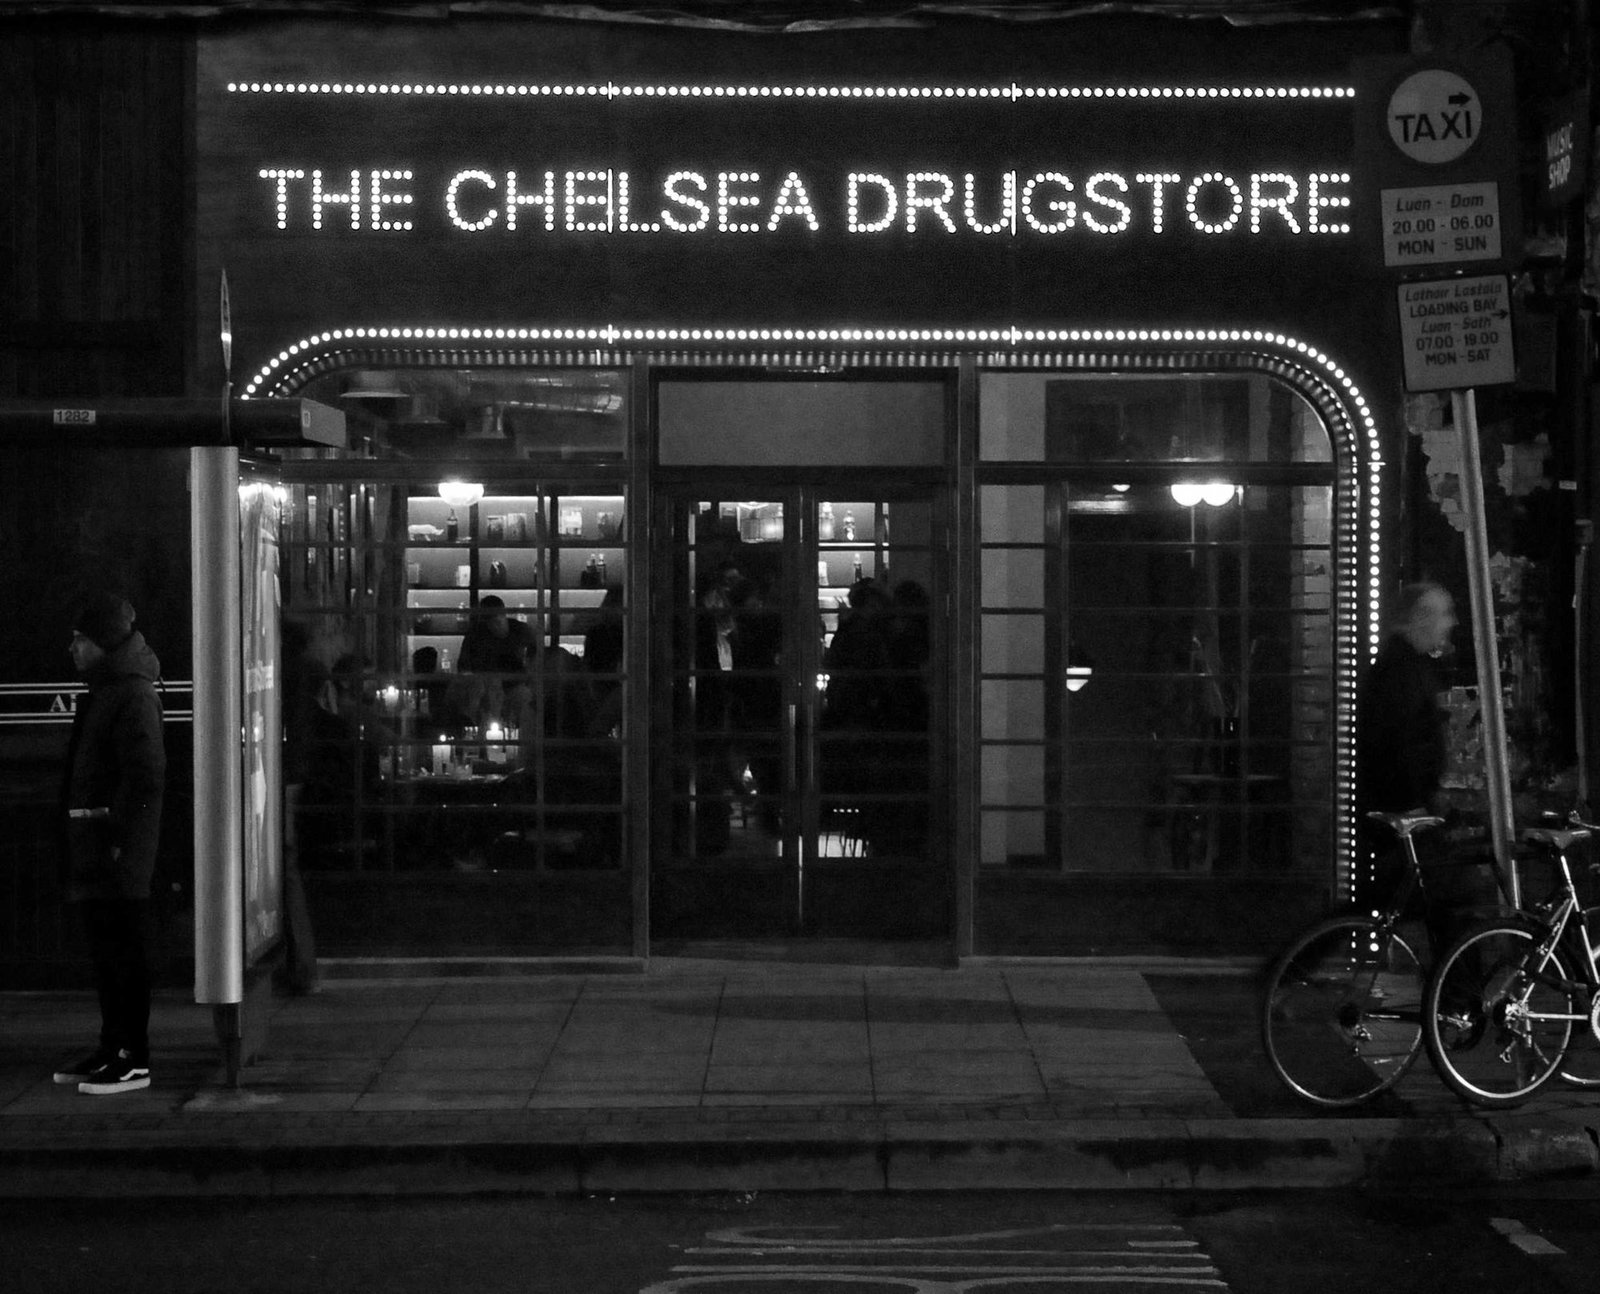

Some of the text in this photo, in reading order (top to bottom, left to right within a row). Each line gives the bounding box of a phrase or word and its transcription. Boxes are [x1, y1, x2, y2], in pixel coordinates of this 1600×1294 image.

[1395, 110, 1473, 143] TAXI
[1549, 154, 1571, 190] SHOP
[257, 168, 1352, 235] THE CHELSEA DRUGSTORE
[1396, 197, 1431, 212] Luan
[1450, 193, 1484, 209] Dom
[1392, 218, 1436, 235] 20.00
[1450, 214, 1494, 231] 06.00
[1398, 239, 1435, 256] MON
[1454, 235, 1487, 252] SUN
[1410, 298, 1498, 318] LOADING BAY
[1421, 320, 1451, 334] Luan
[1416, 335, 1454, 351] 07.00
[1425, 352, 1457, 367] MON
[1467, 348, 1491, 363] SAT
[56, 410, 90, 423] 1282
